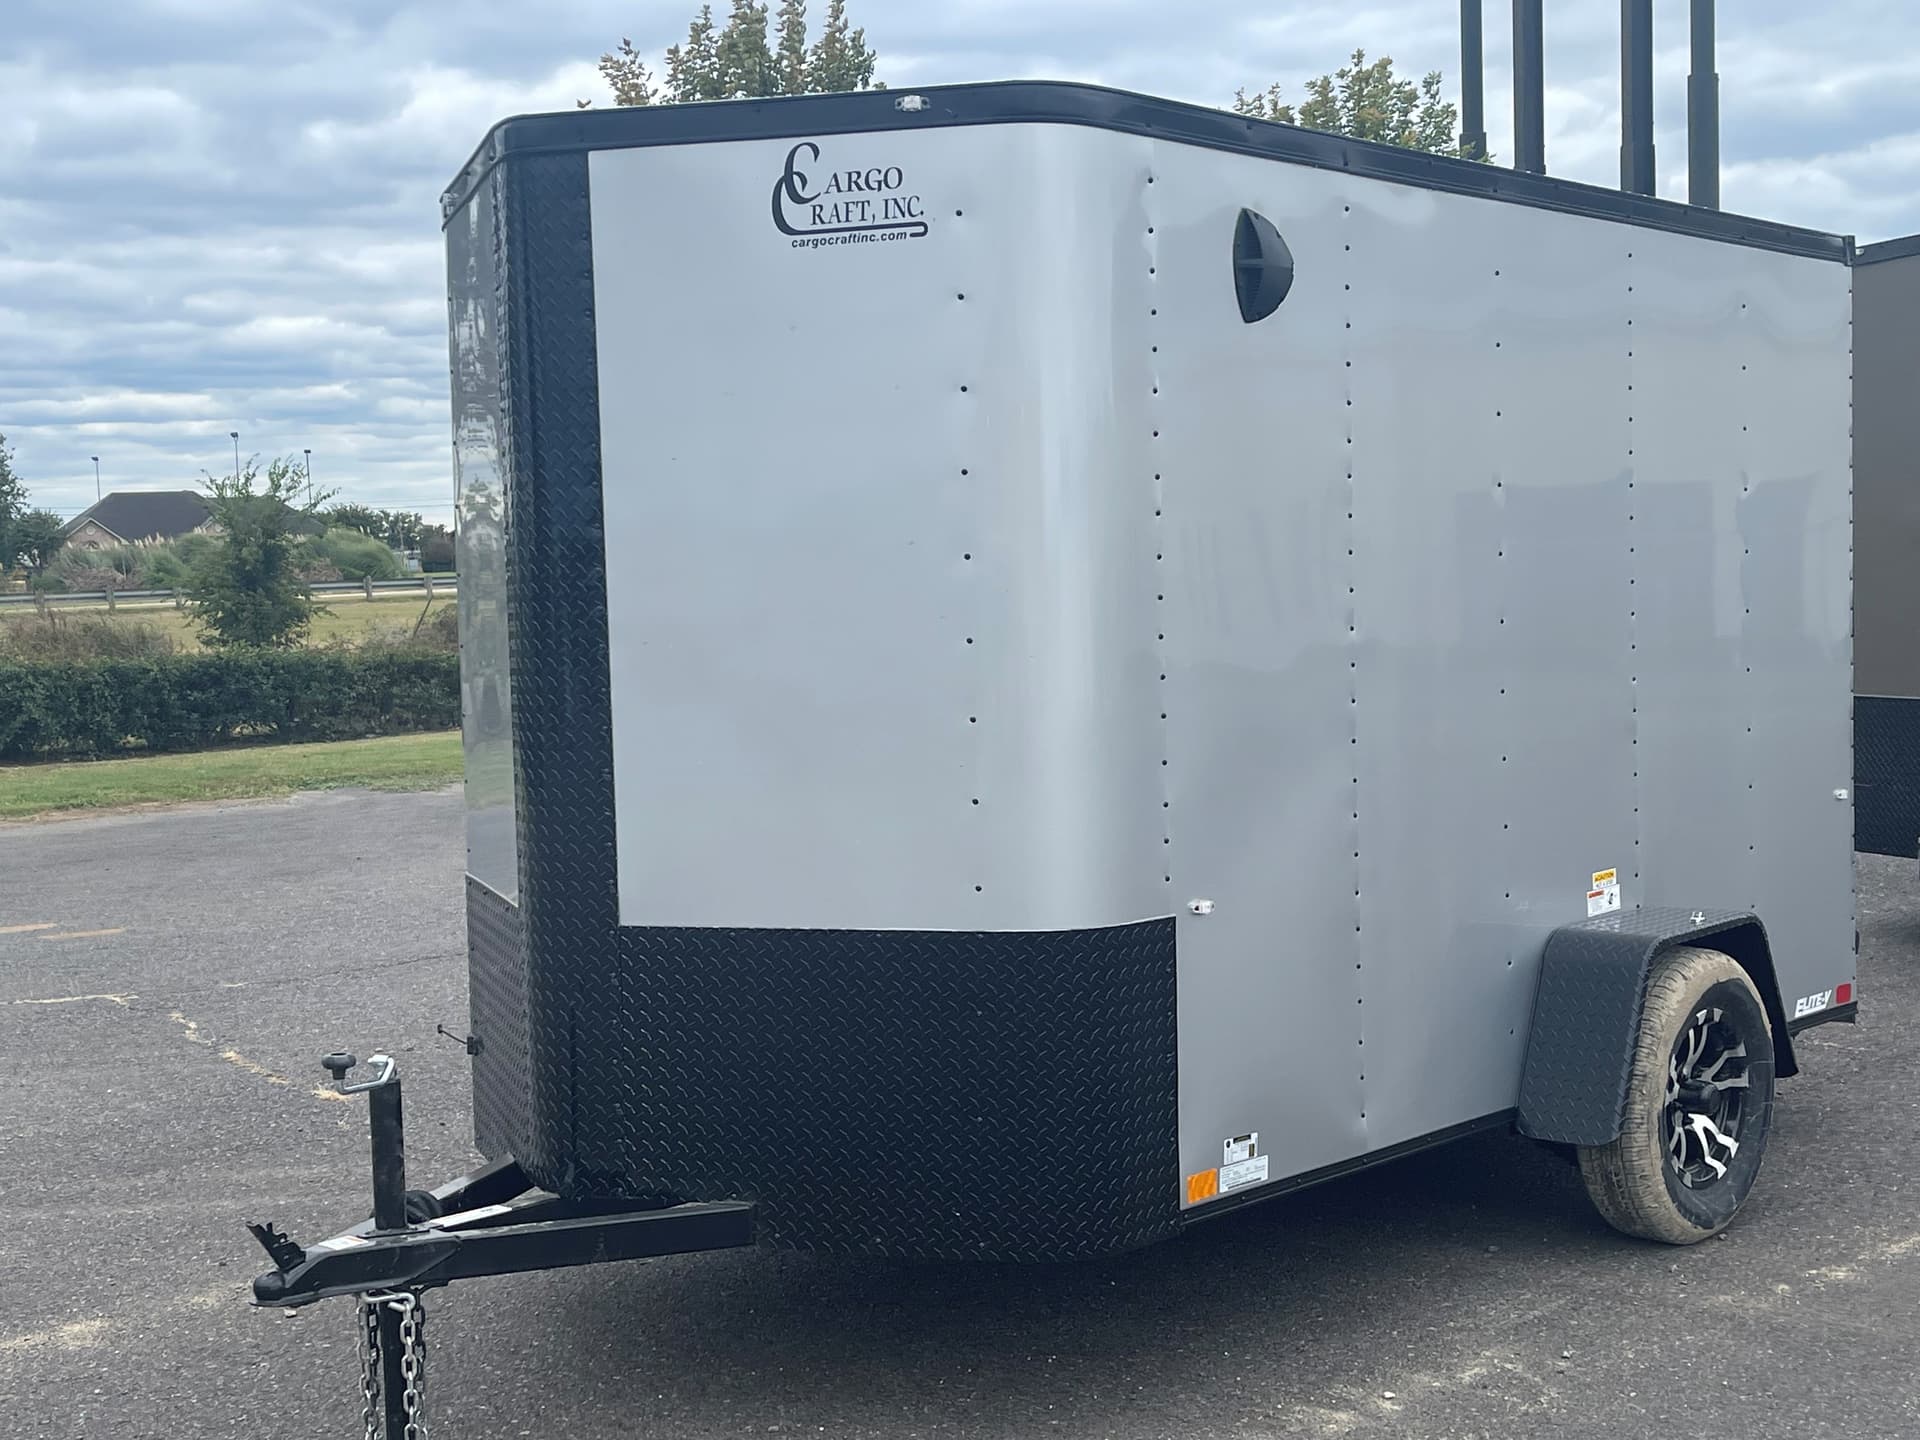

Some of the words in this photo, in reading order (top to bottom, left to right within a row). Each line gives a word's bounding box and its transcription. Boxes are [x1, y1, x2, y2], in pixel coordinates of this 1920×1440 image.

[784, 142, 903, 204] CARGO
[882, 195, 924, 220] INC.
[791, 231, 907, 249] cargocraftinc.com
